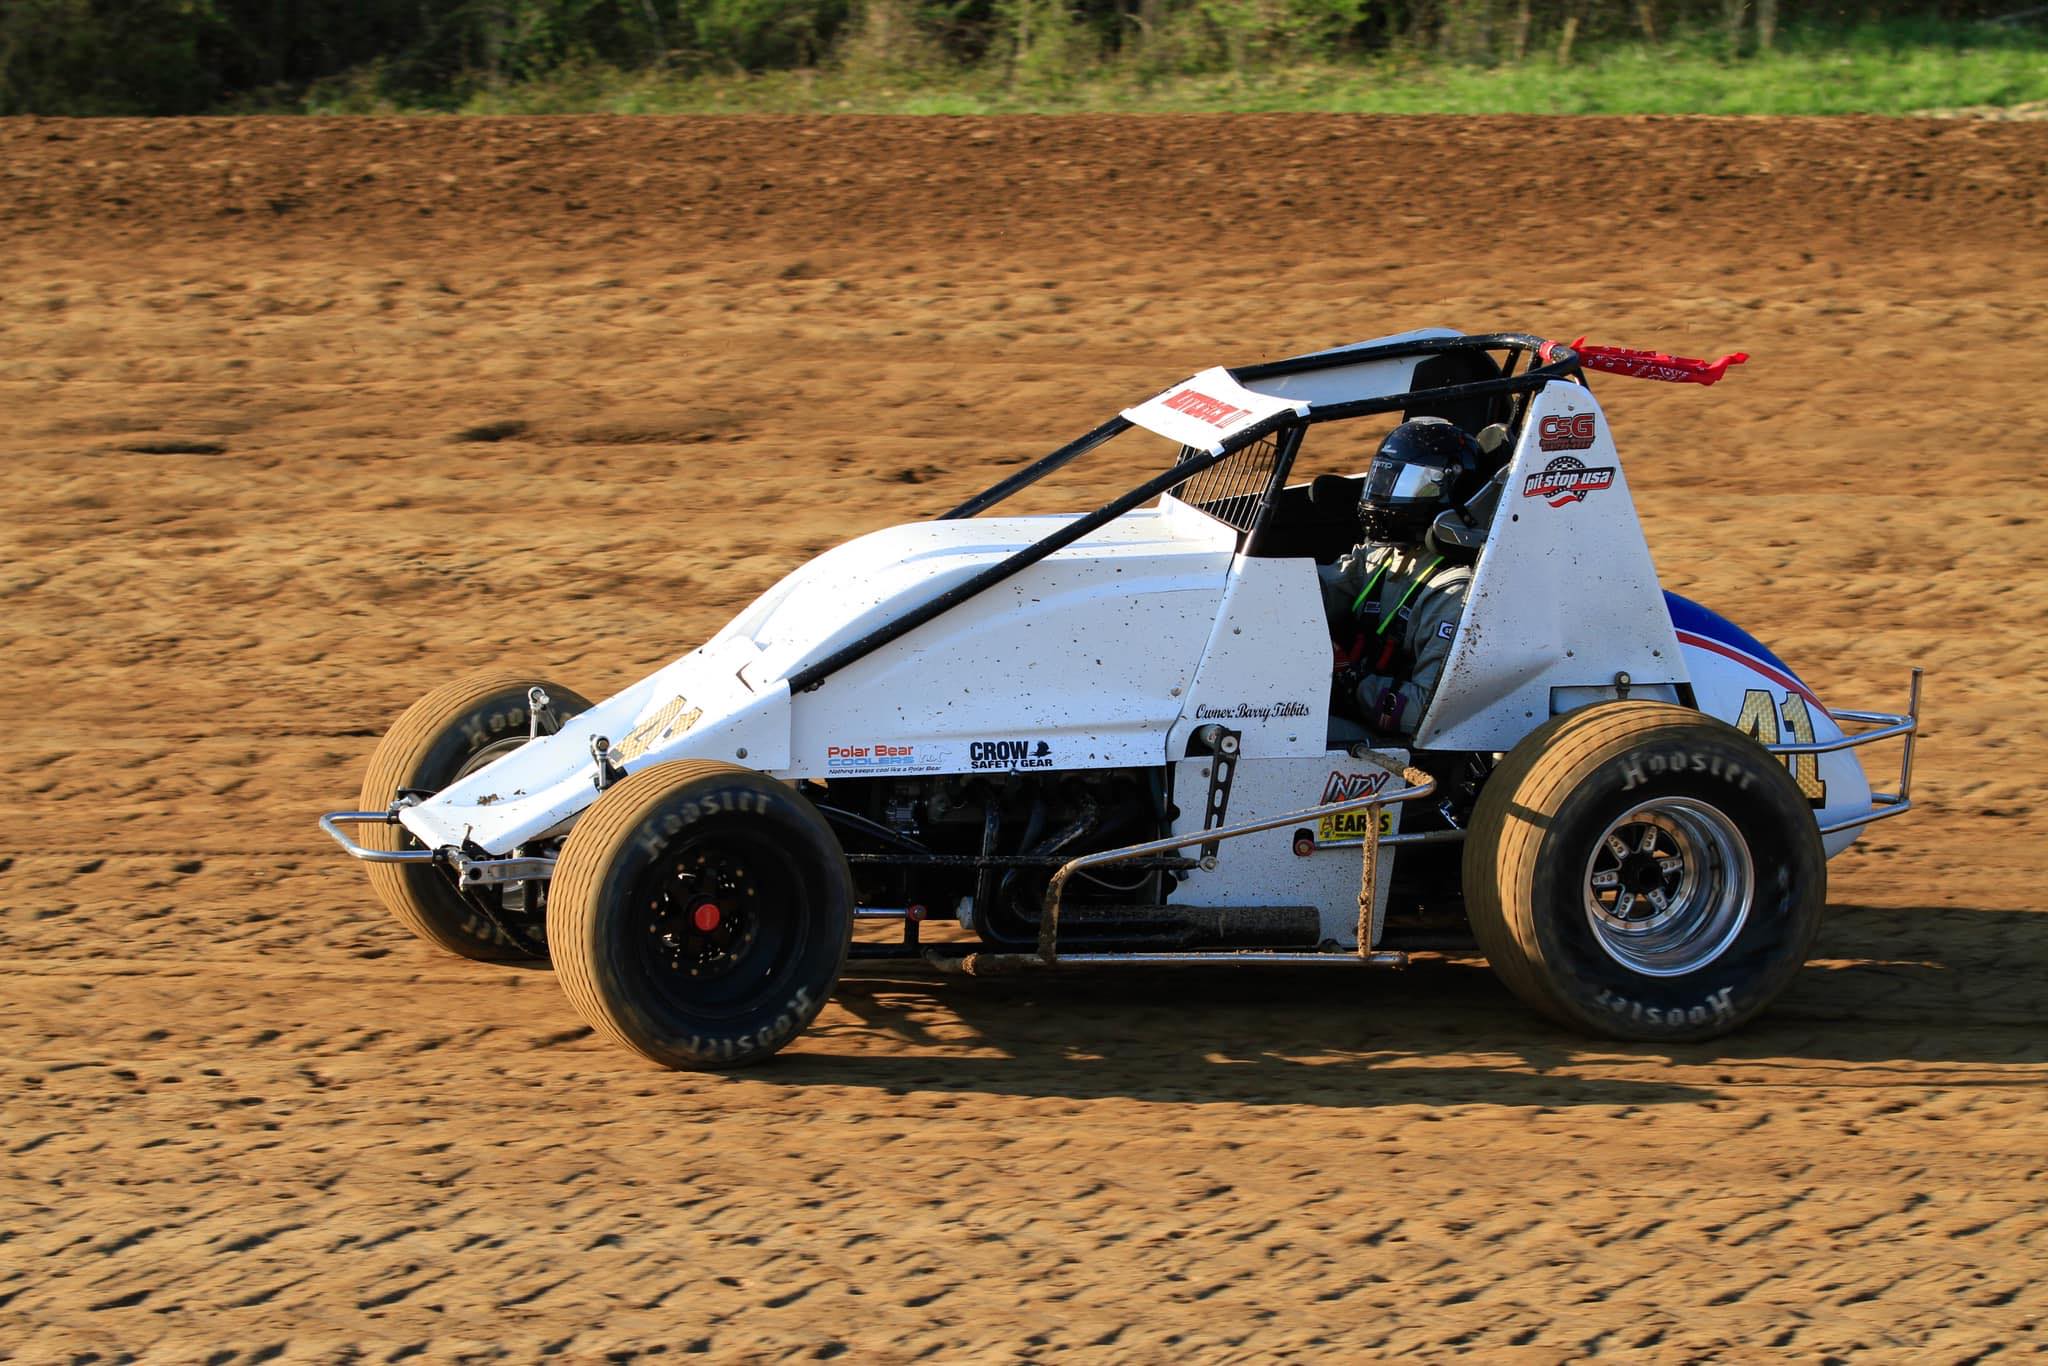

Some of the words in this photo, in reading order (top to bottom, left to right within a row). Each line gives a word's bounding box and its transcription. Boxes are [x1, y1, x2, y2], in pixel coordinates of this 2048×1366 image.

[1525, 474, 1544, 494] pit
[1543, 471, 1579, 488] stop
[1581, 471, 1611, 485] usa
[1235, 702, 1271, 722] Barry
[1271, 701, 1309, 717] Tibbits
[828, 745, 870, 758] Polar
[875, 745, 914, 756] Bear
[828, 756, 915, 766] COOLERS
[970, 741, 1029, 761] CROW
[971, 760, 1018, 769] SAFETY
[1021, 759, 1053, 767] GEAR
[1618, 751, 1758, 792] Hoosier
[1320, 771, 1390, 806] INDY
